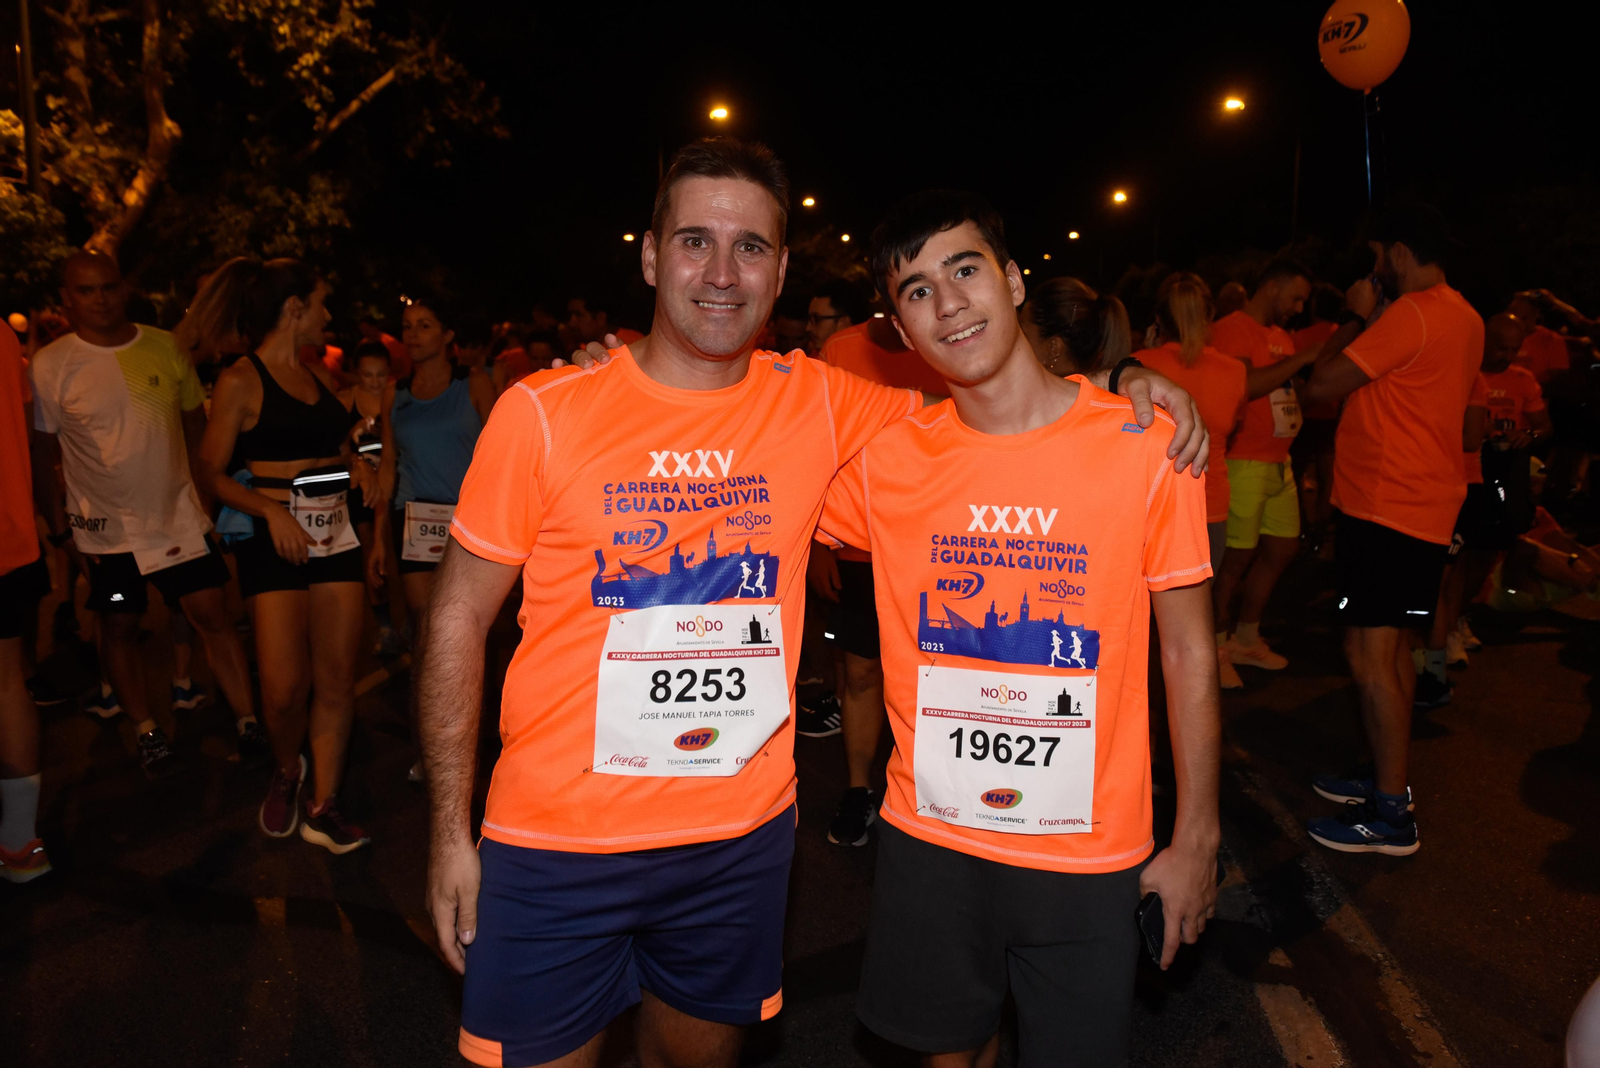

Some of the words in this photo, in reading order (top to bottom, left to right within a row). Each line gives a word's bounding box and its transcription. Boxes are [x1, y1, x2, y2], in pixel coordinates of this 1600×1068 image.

[647, 449, 734, 478] XXXV
[603, 481, 681, 495] CARRERA
[687, 474, 768, 494] NOCTURNA
[604, 496, 612, 514] DEL
[616, 488, 770, 513] GUADALQUIVIR
[304, 510, 343, 528] 16410
[967, 504, 1058, 536] XXXV
[420, 524, 450, 537] 948
[932, 534, 999, 549] CARRERA
[1006, 538, 1088, 556] NOCTURNA
[940, 549, 1088, 574] GUADALQUIVIR
[597, 596, 625, 606] 2023
[632, 652, 662, 660] CARRERA
[663, 651, 698, 659] NOCTURNA
[699, 650, 710, 658] DEL
[711, 650, 752, 658] GUADALQUIVIR
[921, 641, 944, 652] 2023
[650, 667, 746, 704] 8253
[638, 712, 660, 720] JOSE
[662, 711, 696, 720] MANUEL
[699, 710, 722, 718] TAPIA
[724, 709, 755, 717] TORRES
[942, 711, 969, 719] CARRERA
[970, 713, 1001, 722] NOCTURNA
[1012, 718, 1058, 726] GUADALQUIVIR
[949, 727, 1061, 767] 19627
[1039, 817, 1083, 826] Cruzcampo
